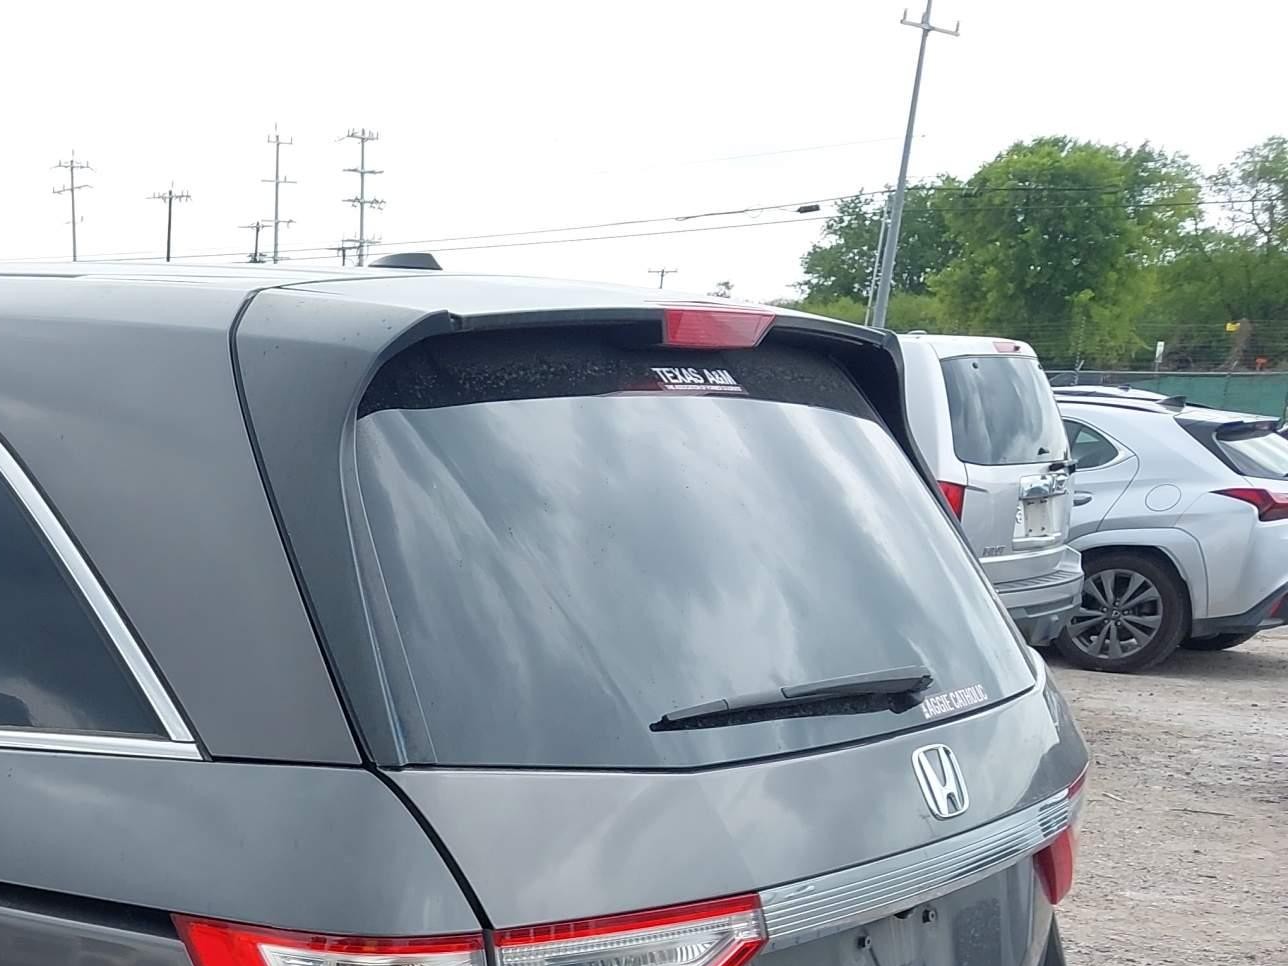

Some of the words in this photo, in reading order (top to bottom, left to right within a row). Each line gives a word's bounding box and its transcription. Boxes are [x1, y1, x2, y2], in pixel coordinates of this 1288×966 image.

[651, 367, 704, 384] TEXAS
[703, 368, 737, 385] A&M
[926, 694, 954, 714] AGGIE
[950, 684, 987, 708] CATHOLIC
